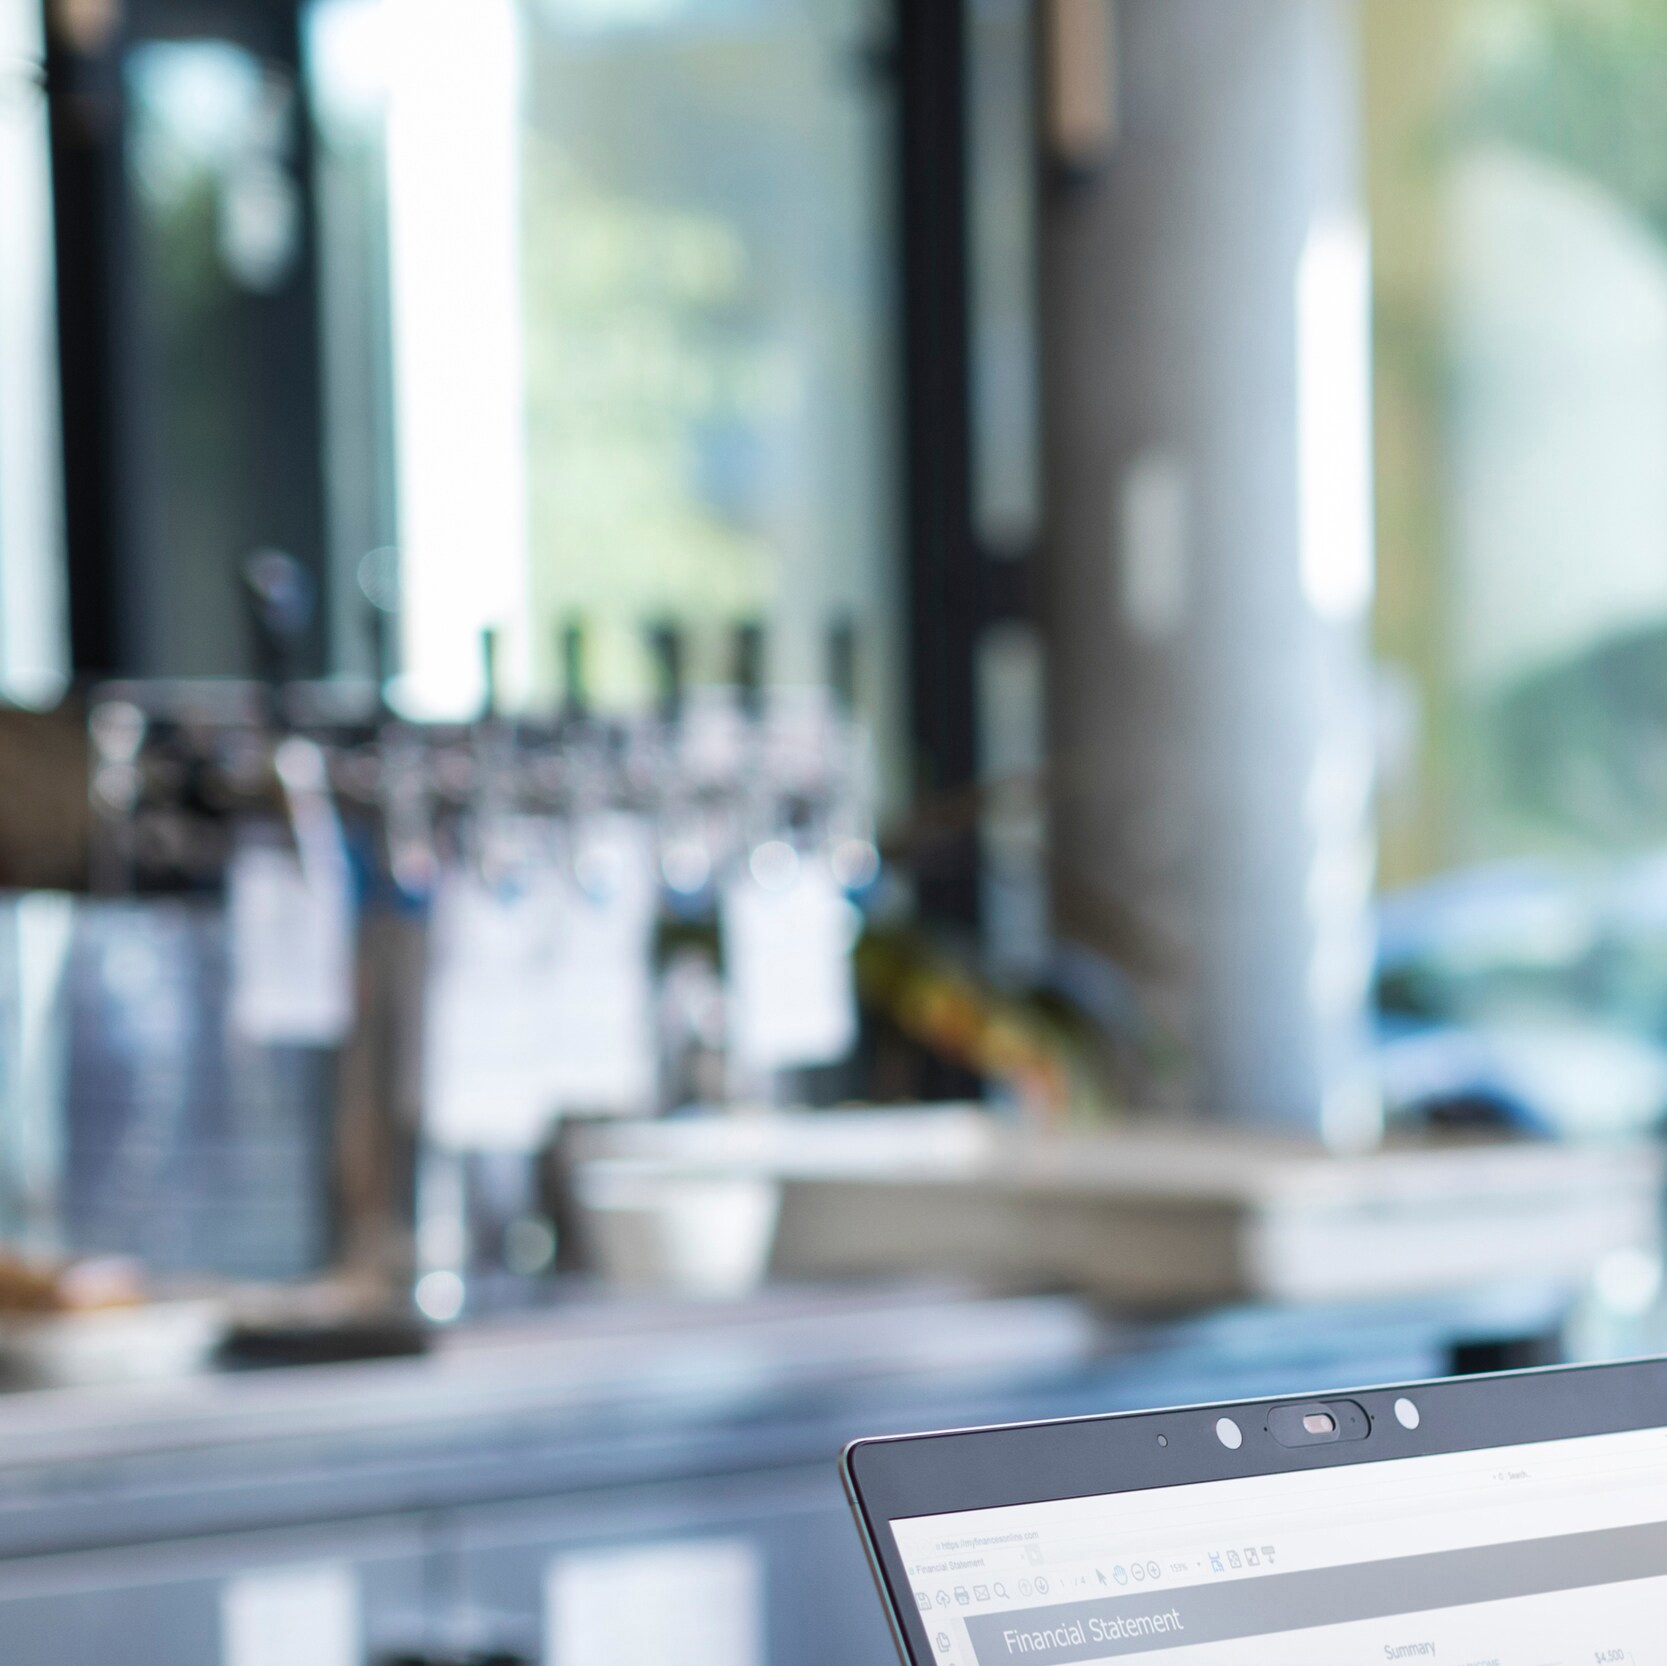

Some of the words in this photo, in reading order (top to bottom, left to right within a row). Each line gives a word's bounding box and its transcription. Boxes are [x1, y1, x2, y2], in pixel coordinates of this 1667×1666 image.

[1003, 1614, 1086, 1655] Financial
[1088, 1608, 1184, 1643] Statement
[1384, 1640, 1436, 1661] Summary
